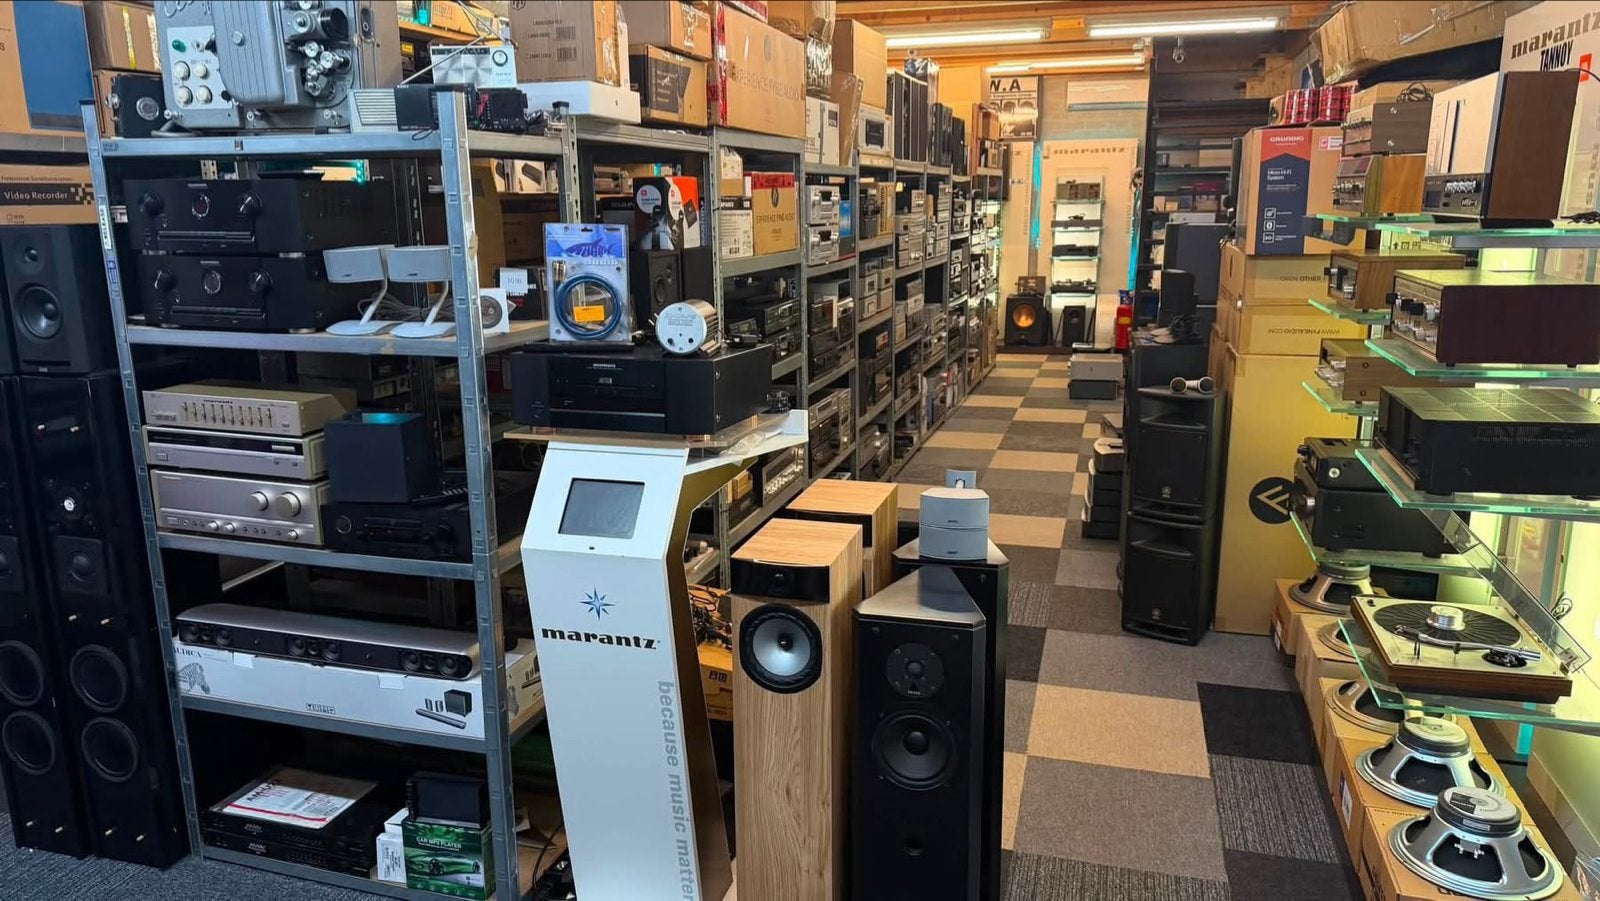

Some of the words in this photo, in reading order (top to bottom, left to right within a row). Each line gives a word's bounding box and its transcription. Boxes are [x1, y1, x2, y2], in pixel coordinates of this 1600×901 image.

[1511, 11, 1600, 59] marantz
[1540, 40, 1574, 72] TANNOY
[4, 191, 30, 200] Video
[32, 191, 68, 200] Recorder
[541, 627, 657, 650] marantz
[658, 681, 679, 767] because
[668, 774, 690, 833] music
[440, 840, 462, 849] PLAYER
